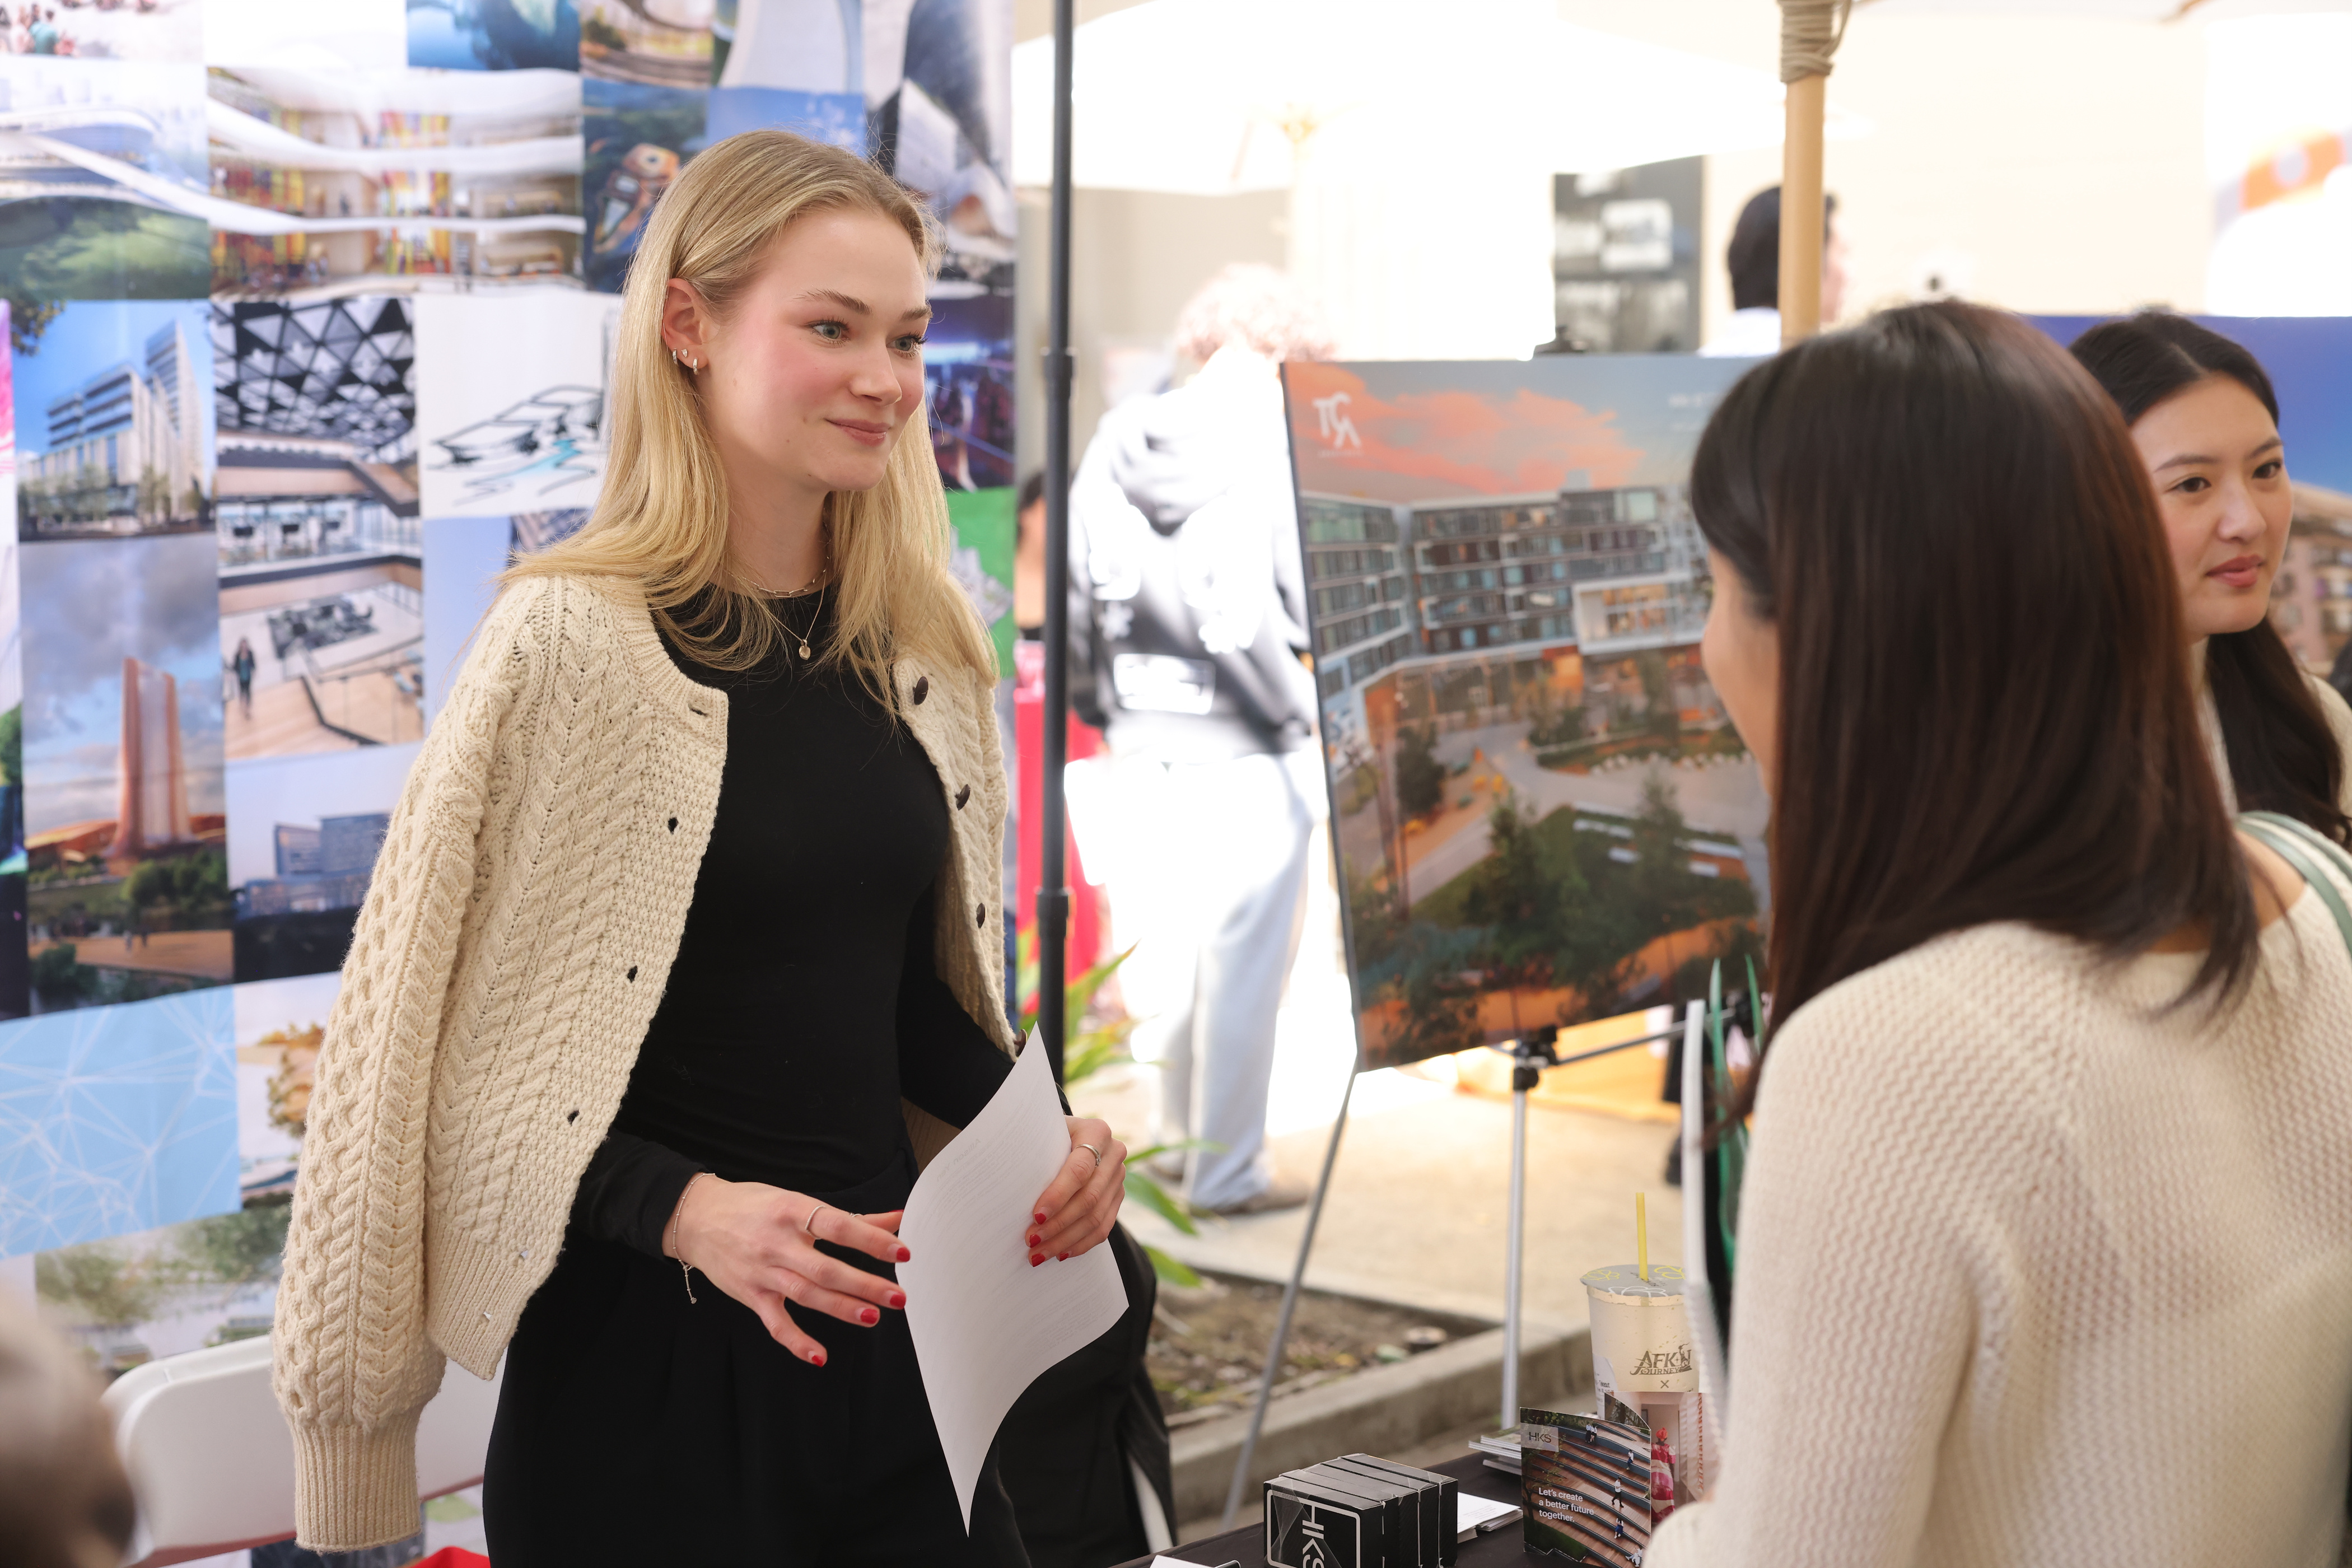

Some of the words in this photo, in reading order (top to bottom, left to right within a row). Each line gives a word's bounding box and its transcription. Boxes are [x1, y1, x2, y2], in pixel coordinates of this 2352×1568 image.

[1630, 1366, 1679, 1375] JOURNEY
[1529, 1431, 1551, 1443] HKS
[1558, 1491, 1583, 1502] create
[1546, 1499, 1570, 1510] better
[1571, 1504, 1594, 1515] future
[1539, 1510, 1575, 1523] together.
